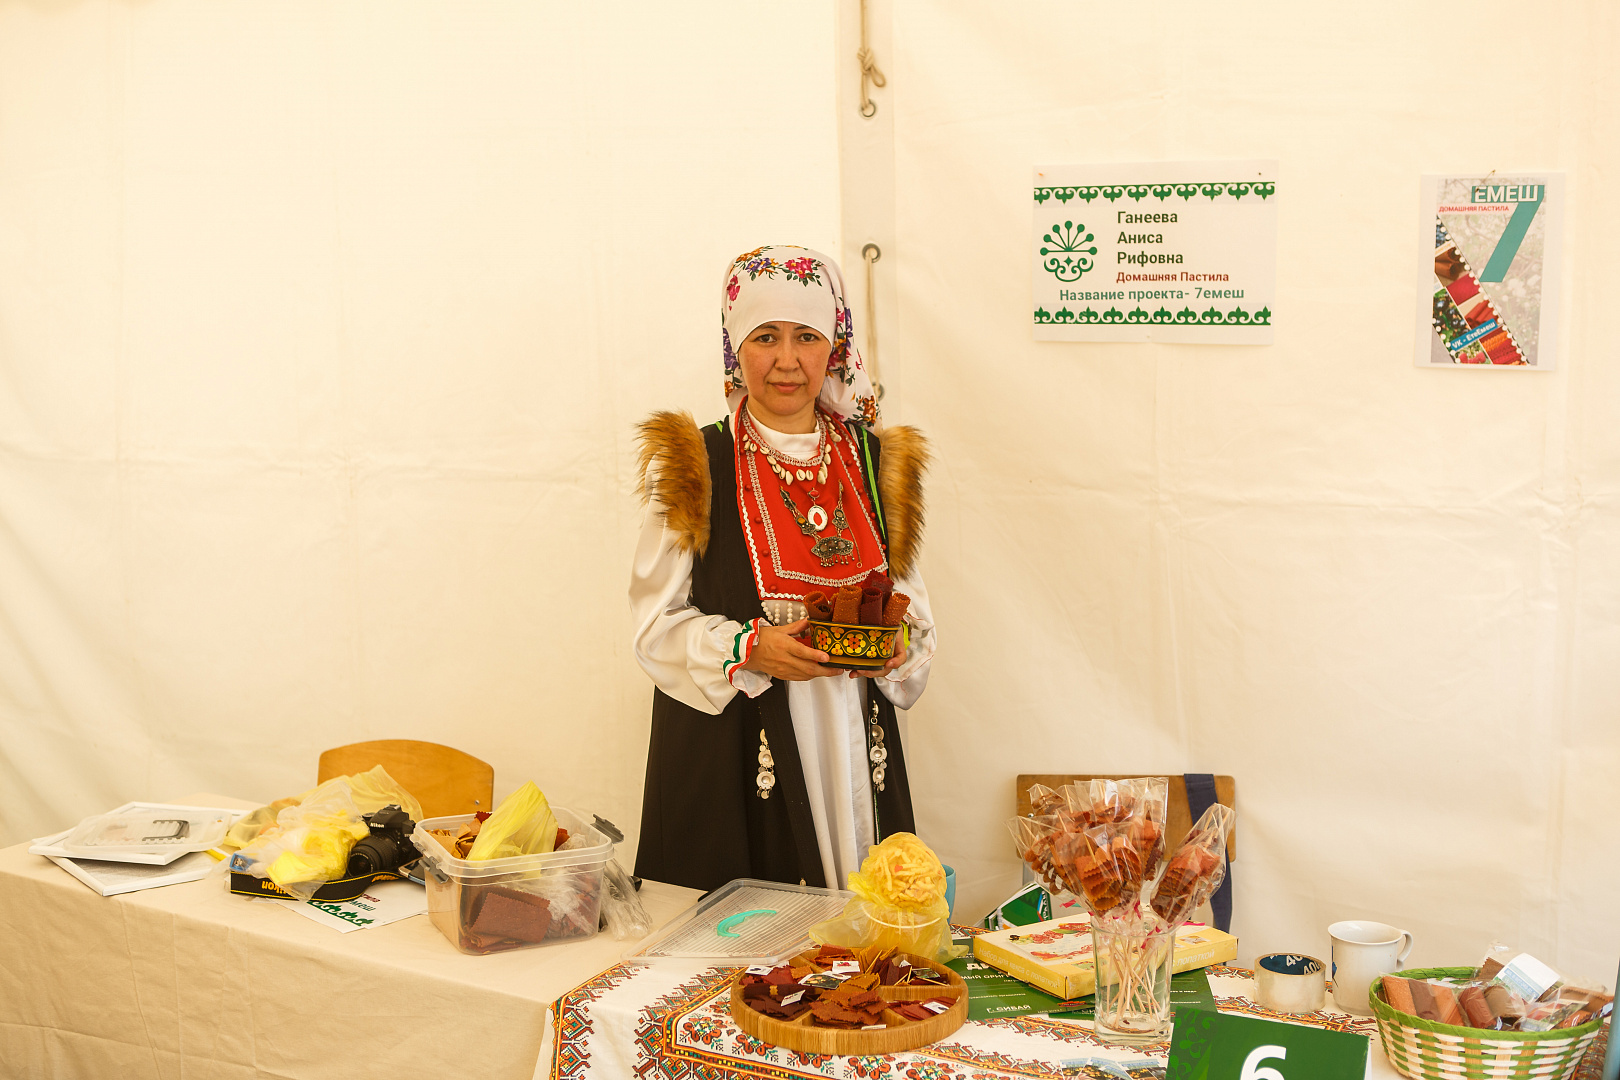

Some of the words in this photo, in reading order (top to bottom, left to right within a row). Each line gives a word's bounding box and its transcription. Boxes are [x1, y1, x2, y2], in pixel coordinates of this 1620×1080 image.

[1475, 185, 1538, 203] ЕМЕШ
[1117, 211, 1178, 224] Ганеева
[1117, 231, 1163, 244] Аниса
[1117, 251, 1184, 267] Рифовна
[1116, 271, 1177, 283] Домашняя
[1180, 271, 1230, 282] Пастила
[1059, 289, 1125, 301] Название
[1128, 289, 1190, 302] проекта-
[1194, 287, 1245, 299] 7емеш
[1177, 949, 1215, 966] лопаткой
[1240, 1044, 1287, 1080] 6
